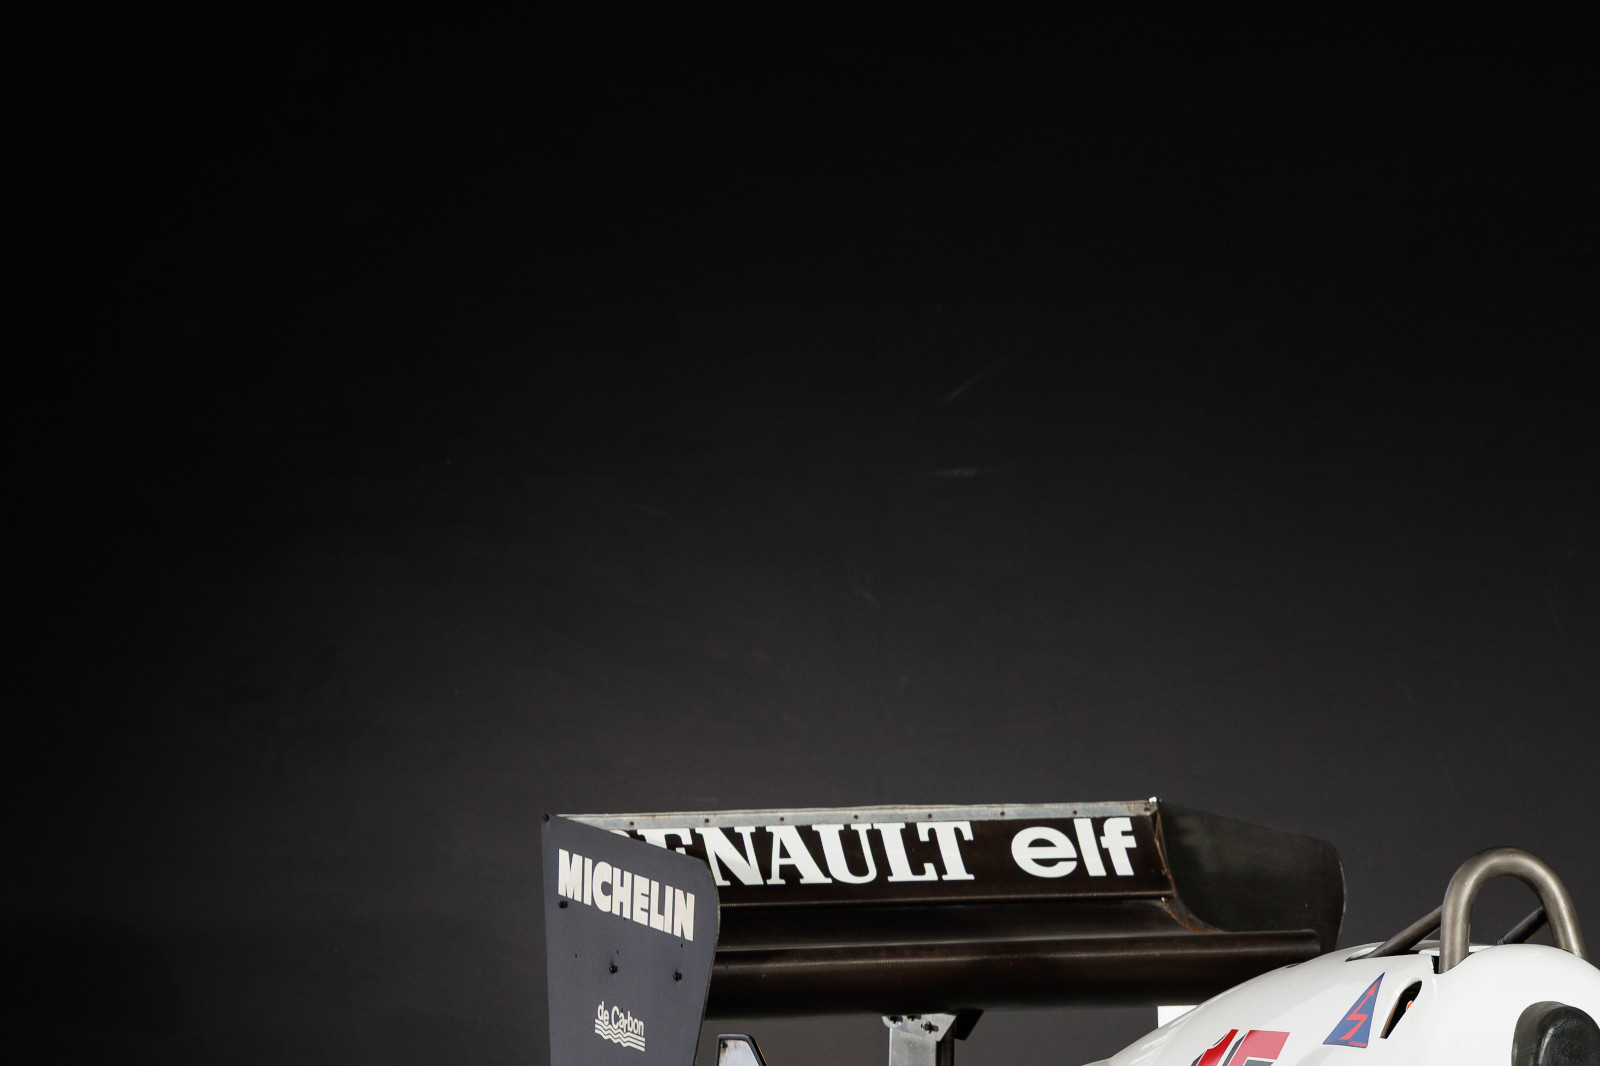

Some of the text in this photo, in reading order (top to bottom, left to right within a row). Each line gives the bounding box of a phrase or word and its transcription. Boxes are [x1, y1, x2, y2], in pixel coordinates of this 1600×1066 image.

[606, 817, 1137, 887] NAULT elf
[558, 849, 695, 941] MICHELIN
[598, 1000, 644, 1036] de Carbon
